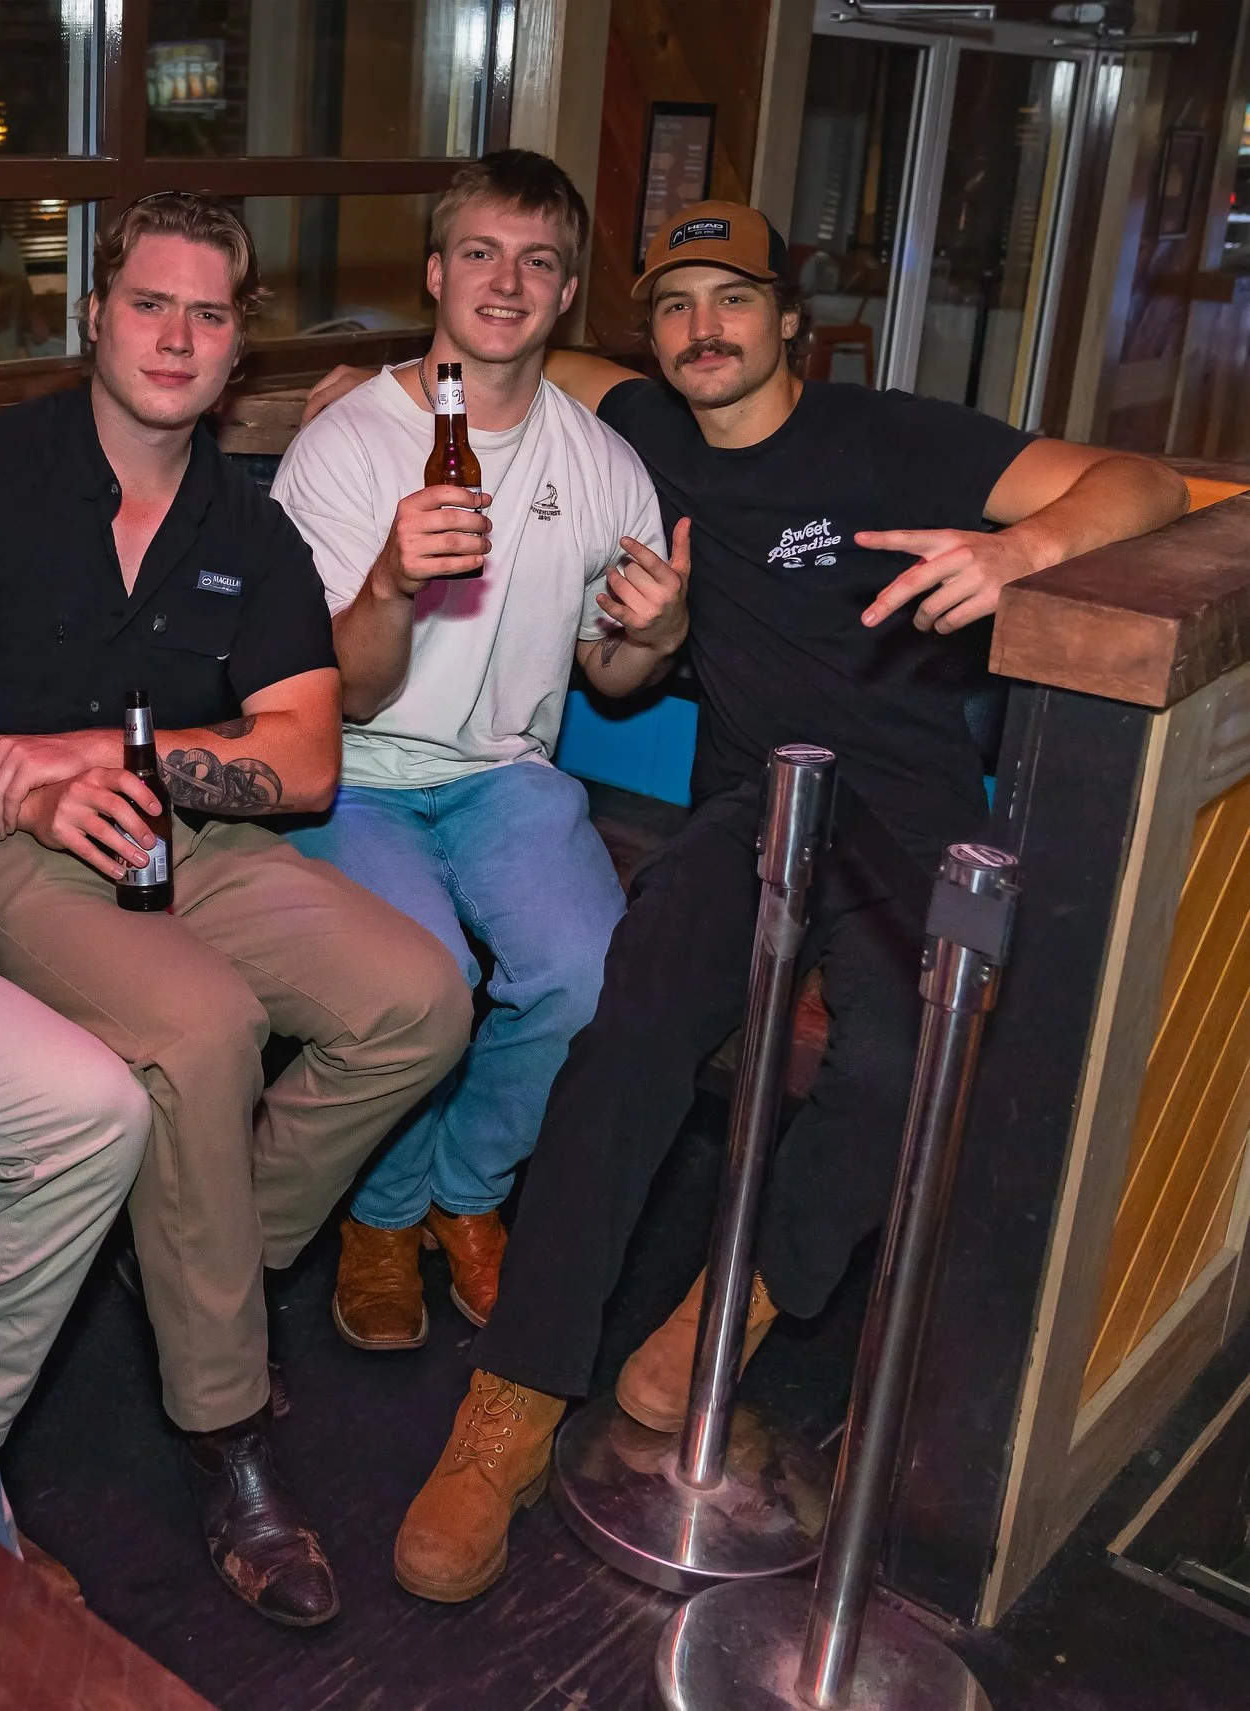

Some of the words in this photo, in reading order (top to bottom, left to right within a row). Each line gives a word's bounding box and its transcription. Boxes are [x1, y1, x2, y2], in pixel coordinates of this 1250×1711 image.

[687, 223, 724, 231] HEAD
[780, 518, 831, 548] Sweet
[767, 535, 842, 563] Paradise
